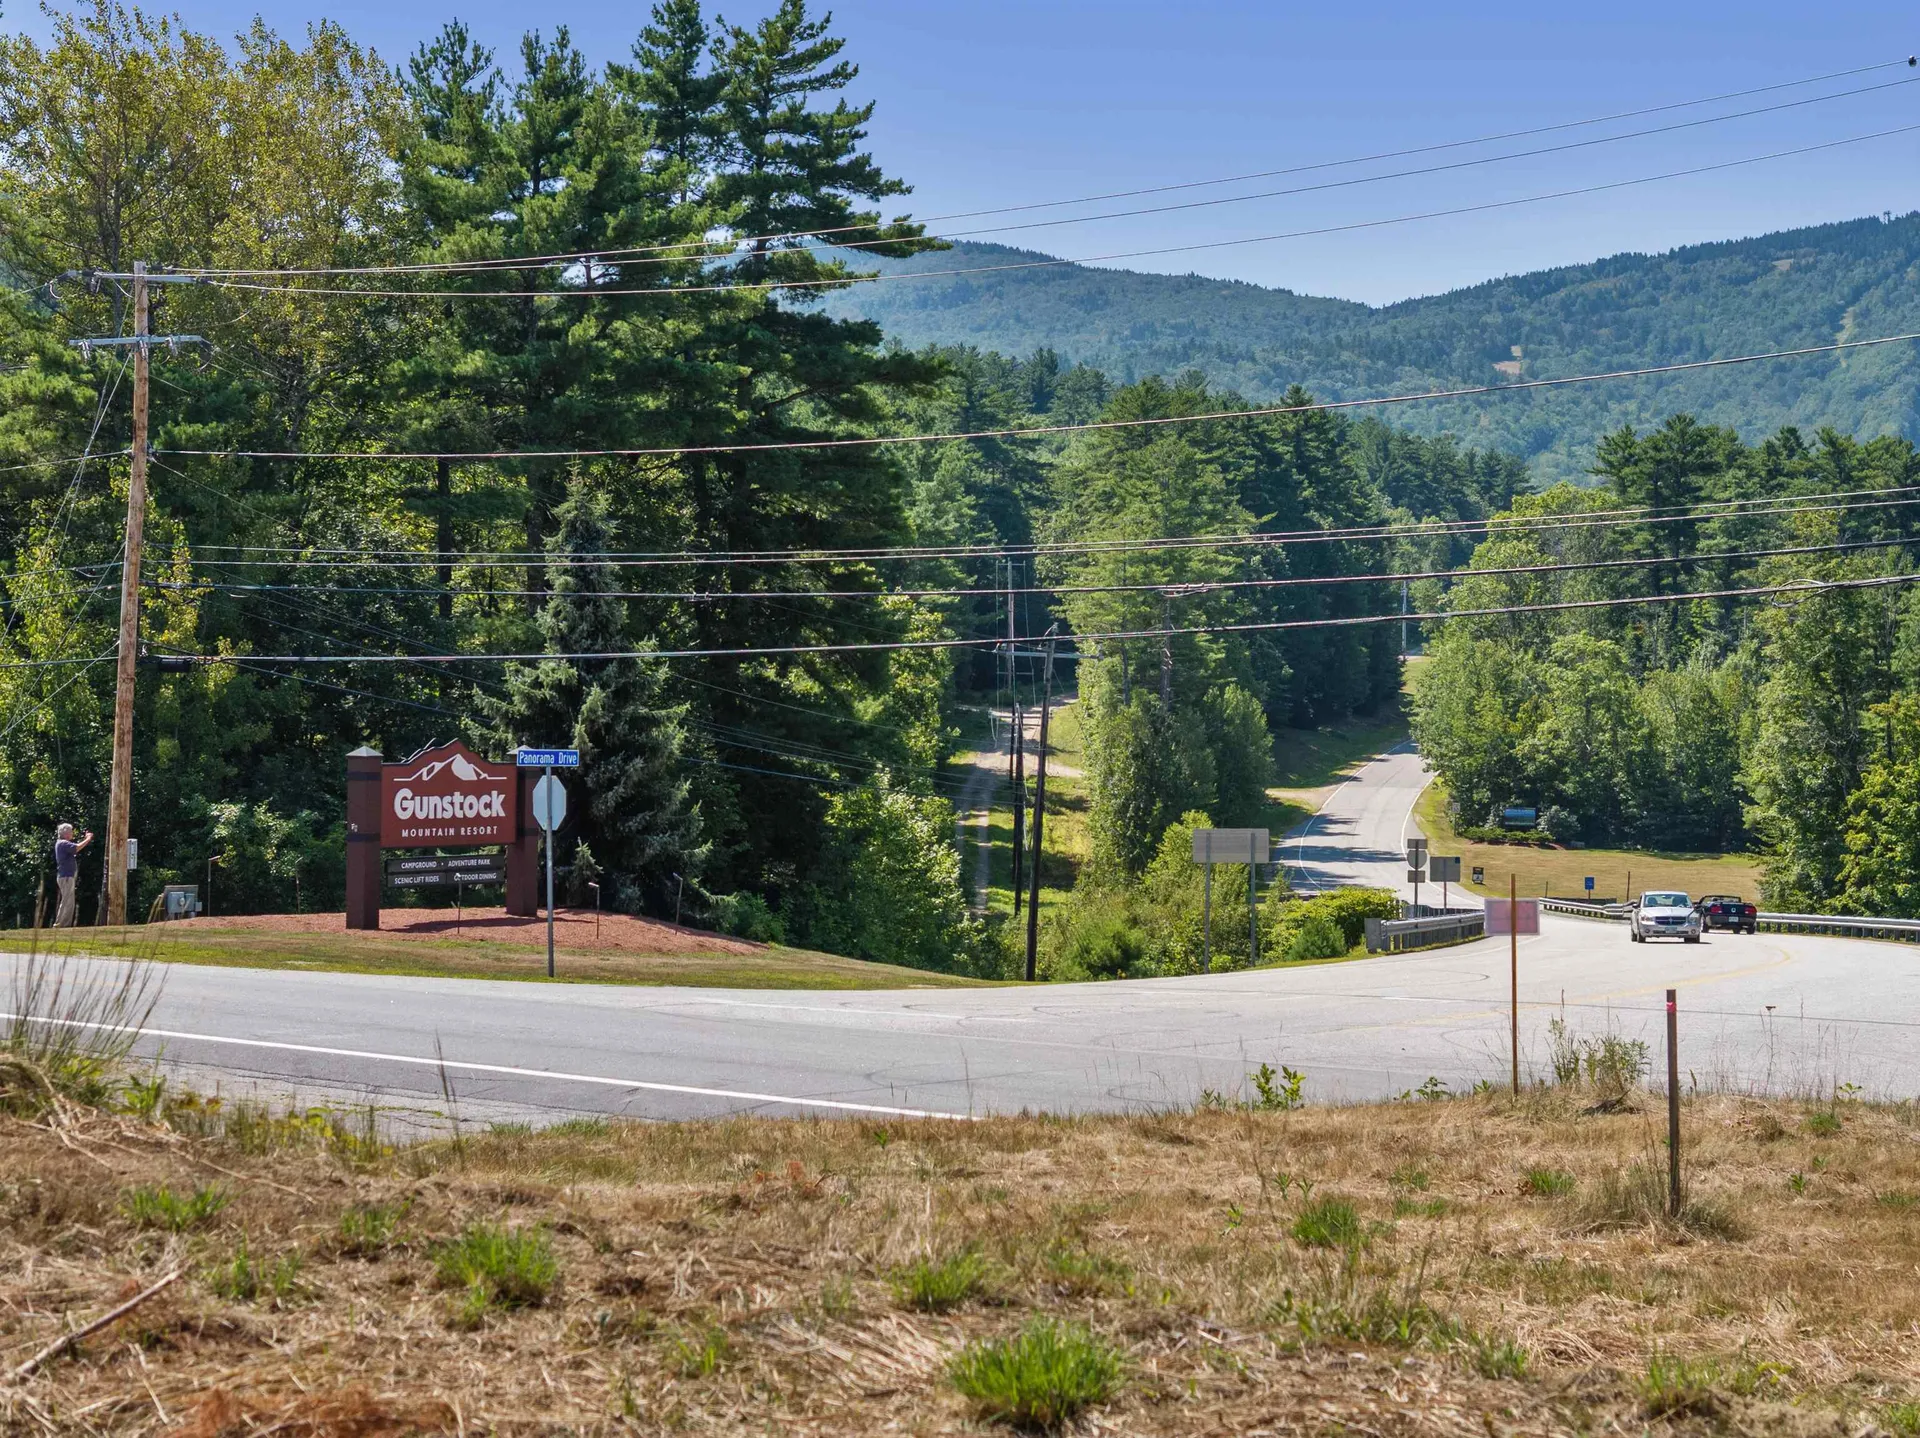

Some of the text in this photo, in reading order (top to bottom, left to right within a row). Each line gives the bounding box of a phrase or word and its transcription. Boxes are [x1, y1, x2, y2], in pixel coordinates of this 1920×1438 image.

[519, 751, 577, 765] Panorama Drive
[394, 788, 506, 820] Gunstock
[402, 826, 498, 838] MOUNTAIN RESORT
[401, 861, 437, 869] CAMPGROUND
[448, 859, 477, 867] ADVENTURE
